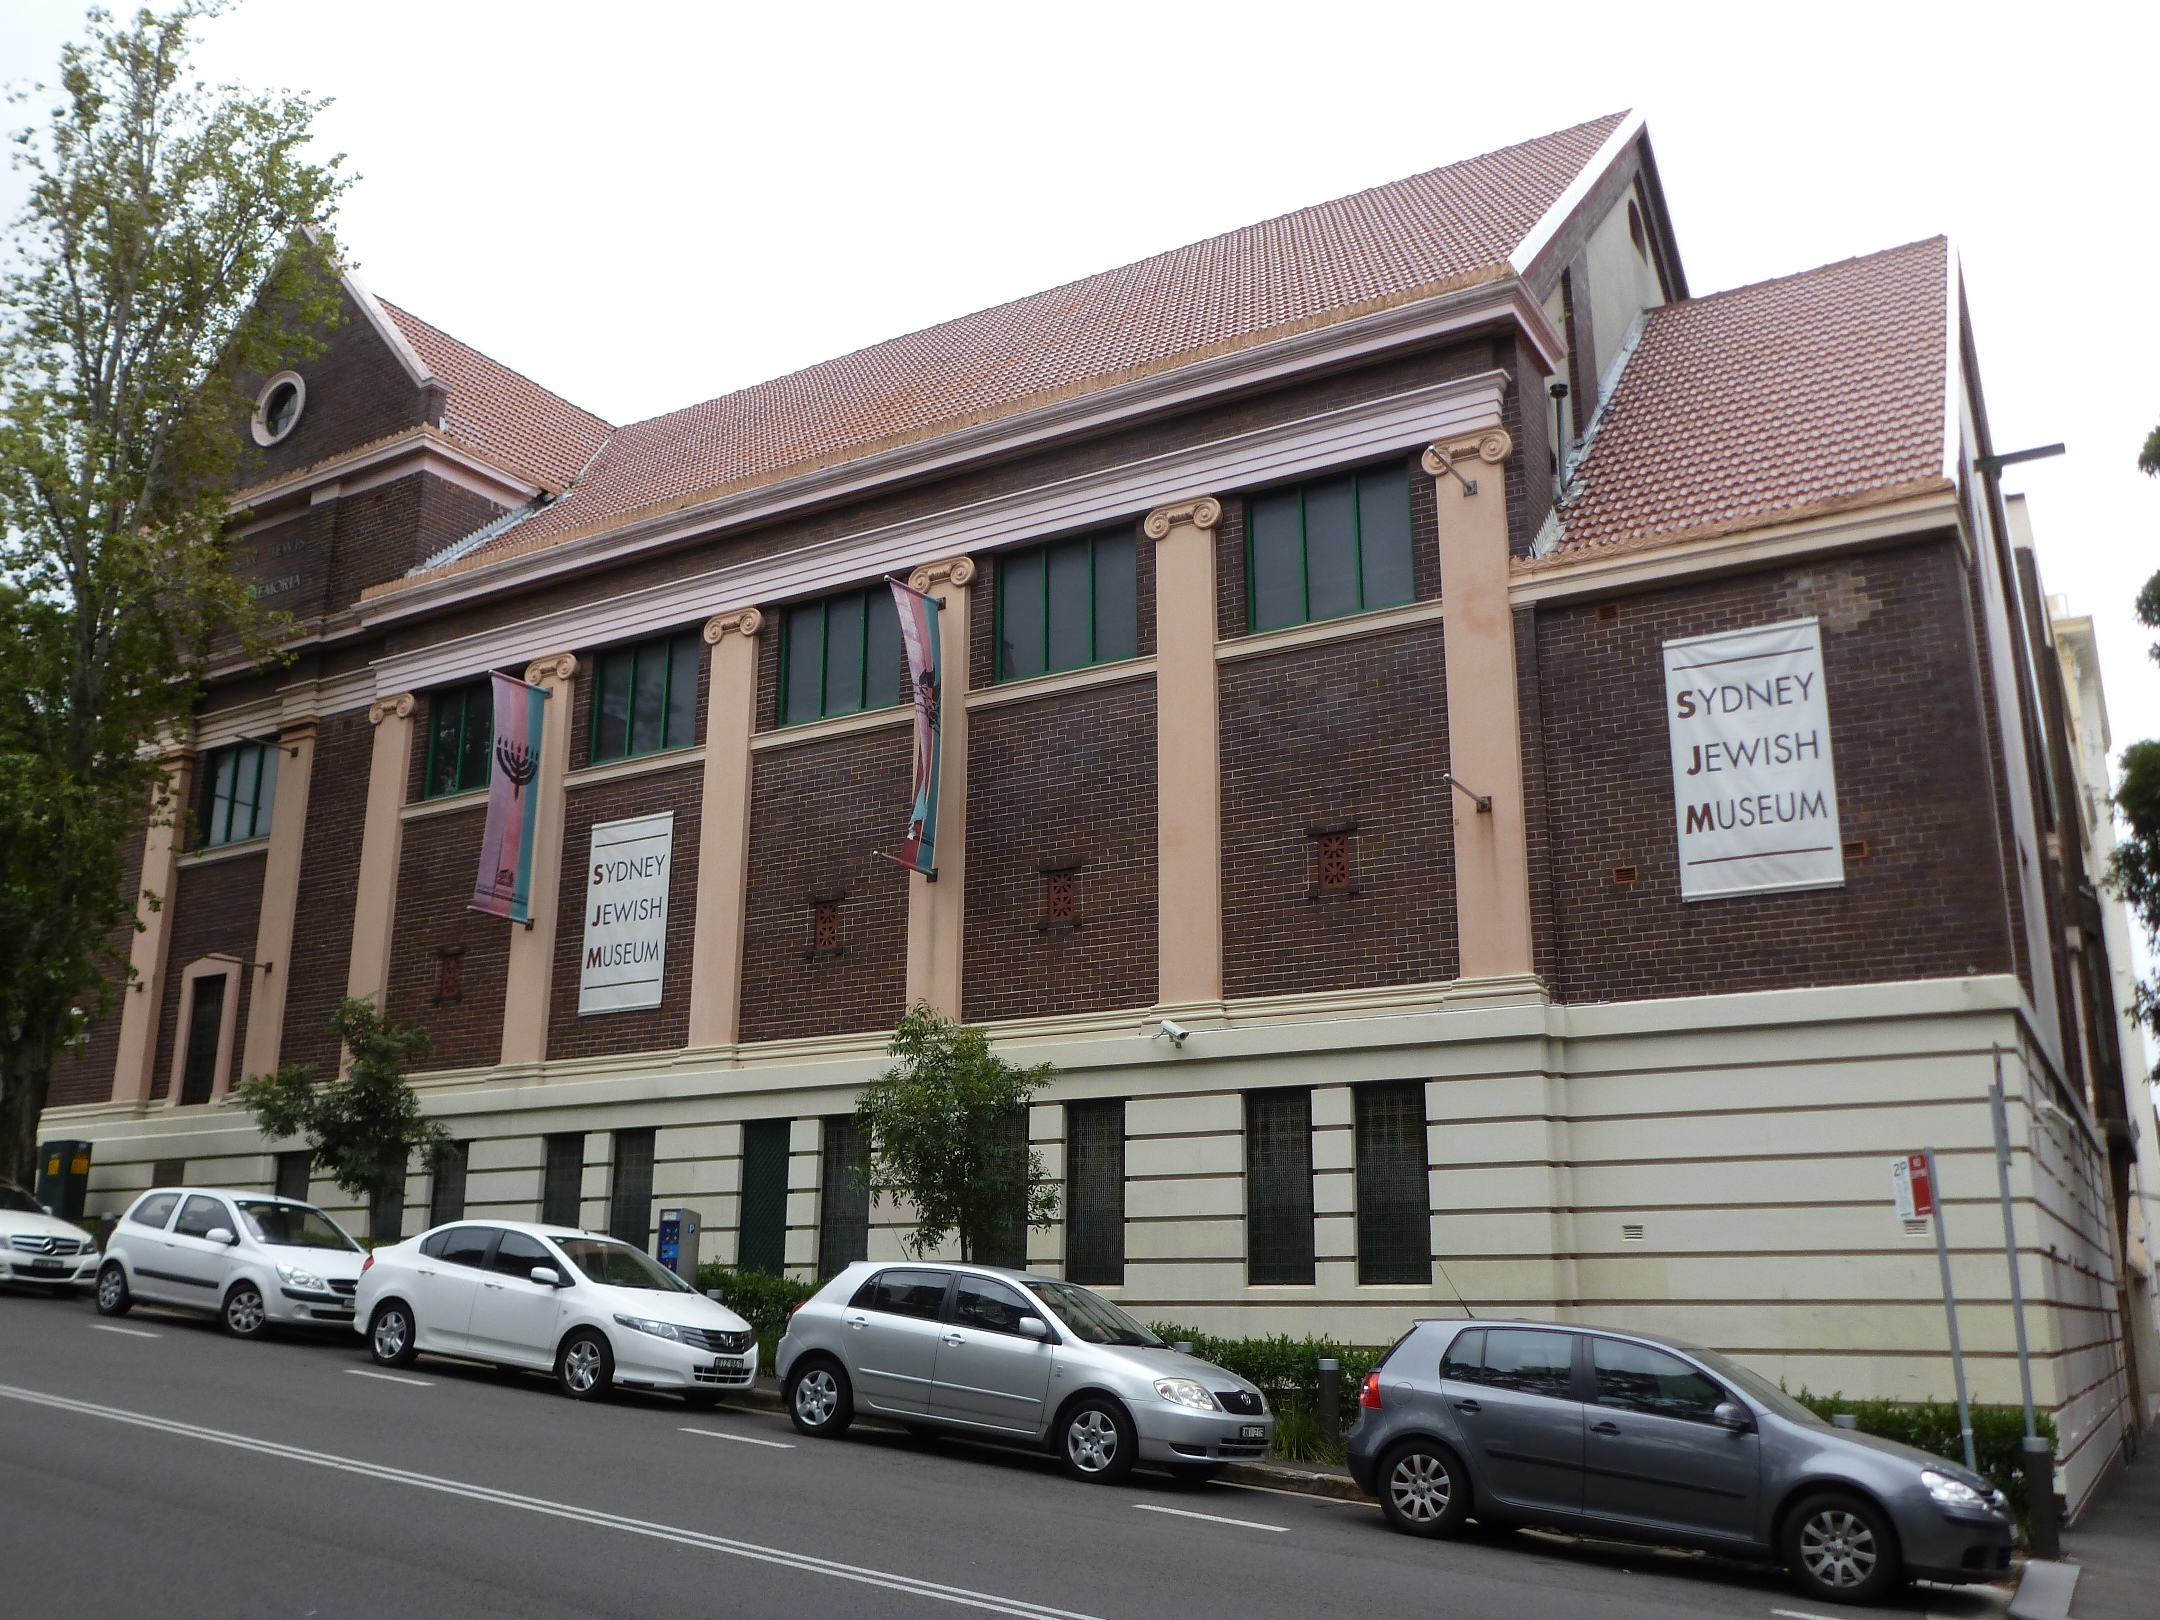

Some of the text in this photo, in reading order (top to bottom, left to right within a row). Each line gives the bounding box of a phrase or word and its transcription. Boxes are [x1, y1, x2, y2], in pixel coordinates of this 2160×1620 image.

[271, 539, 304, 557] JEWIS
[1676, 672, 1814, 719] SYDNEY
[1686, 730, 1819, 776] JEWISH
[1686, 789, 1828, 834] MUSEUM
[593, 854, 666, 885] SYDNEY
[592, 896, 663, 927] JEWISH
[586, 939, 659, 969] MUSEUM
[1893, 1161, 1907, 1177] 2P
